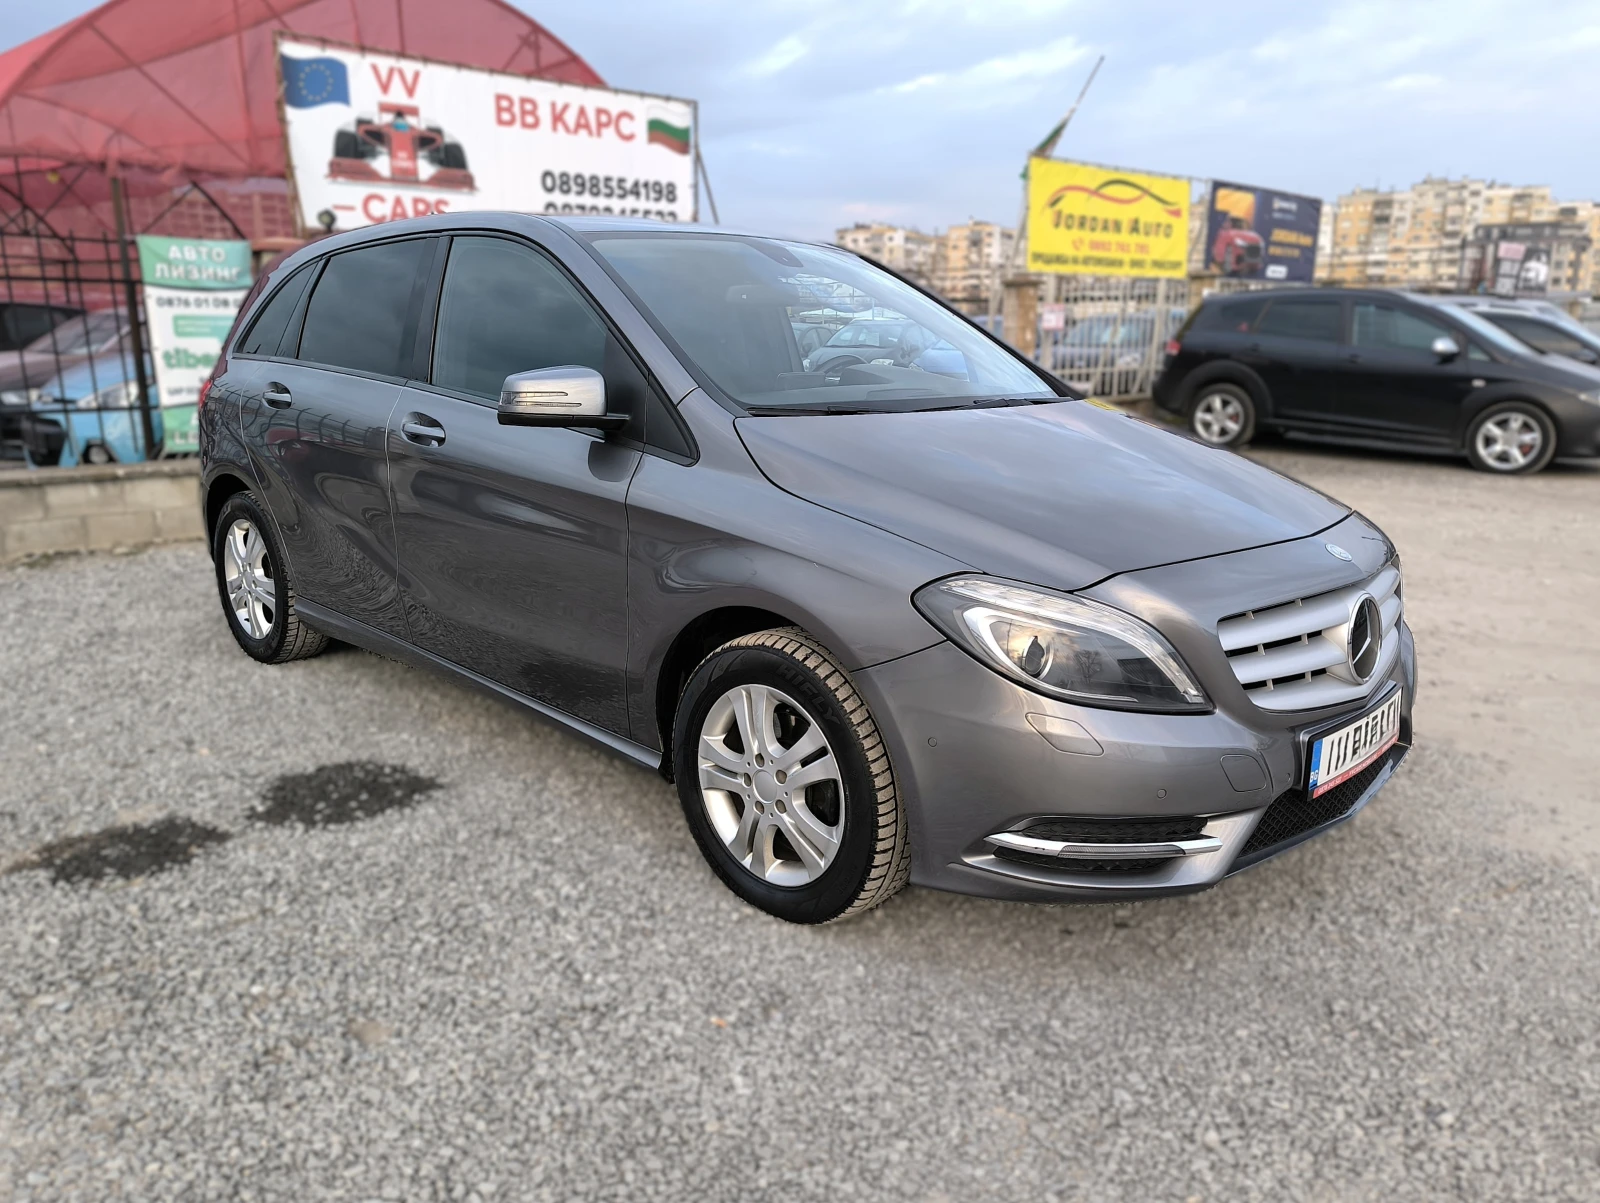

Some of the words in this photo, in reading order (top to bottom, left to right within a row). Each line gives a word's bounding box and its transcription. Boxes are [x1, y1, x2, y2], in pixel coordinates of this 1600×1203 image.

[370, 63, 421, 98] VV
[550, 100, 636, 142] КАРС
[541, 170, 677, 203] 0898554198
[168, 245, 226, 263] АВТО
[155, 263, 242, 282] ЛИЗИНГ
[775, 663, 841, 725] HIFLY
[1310, 769, 1319, 783] BG
